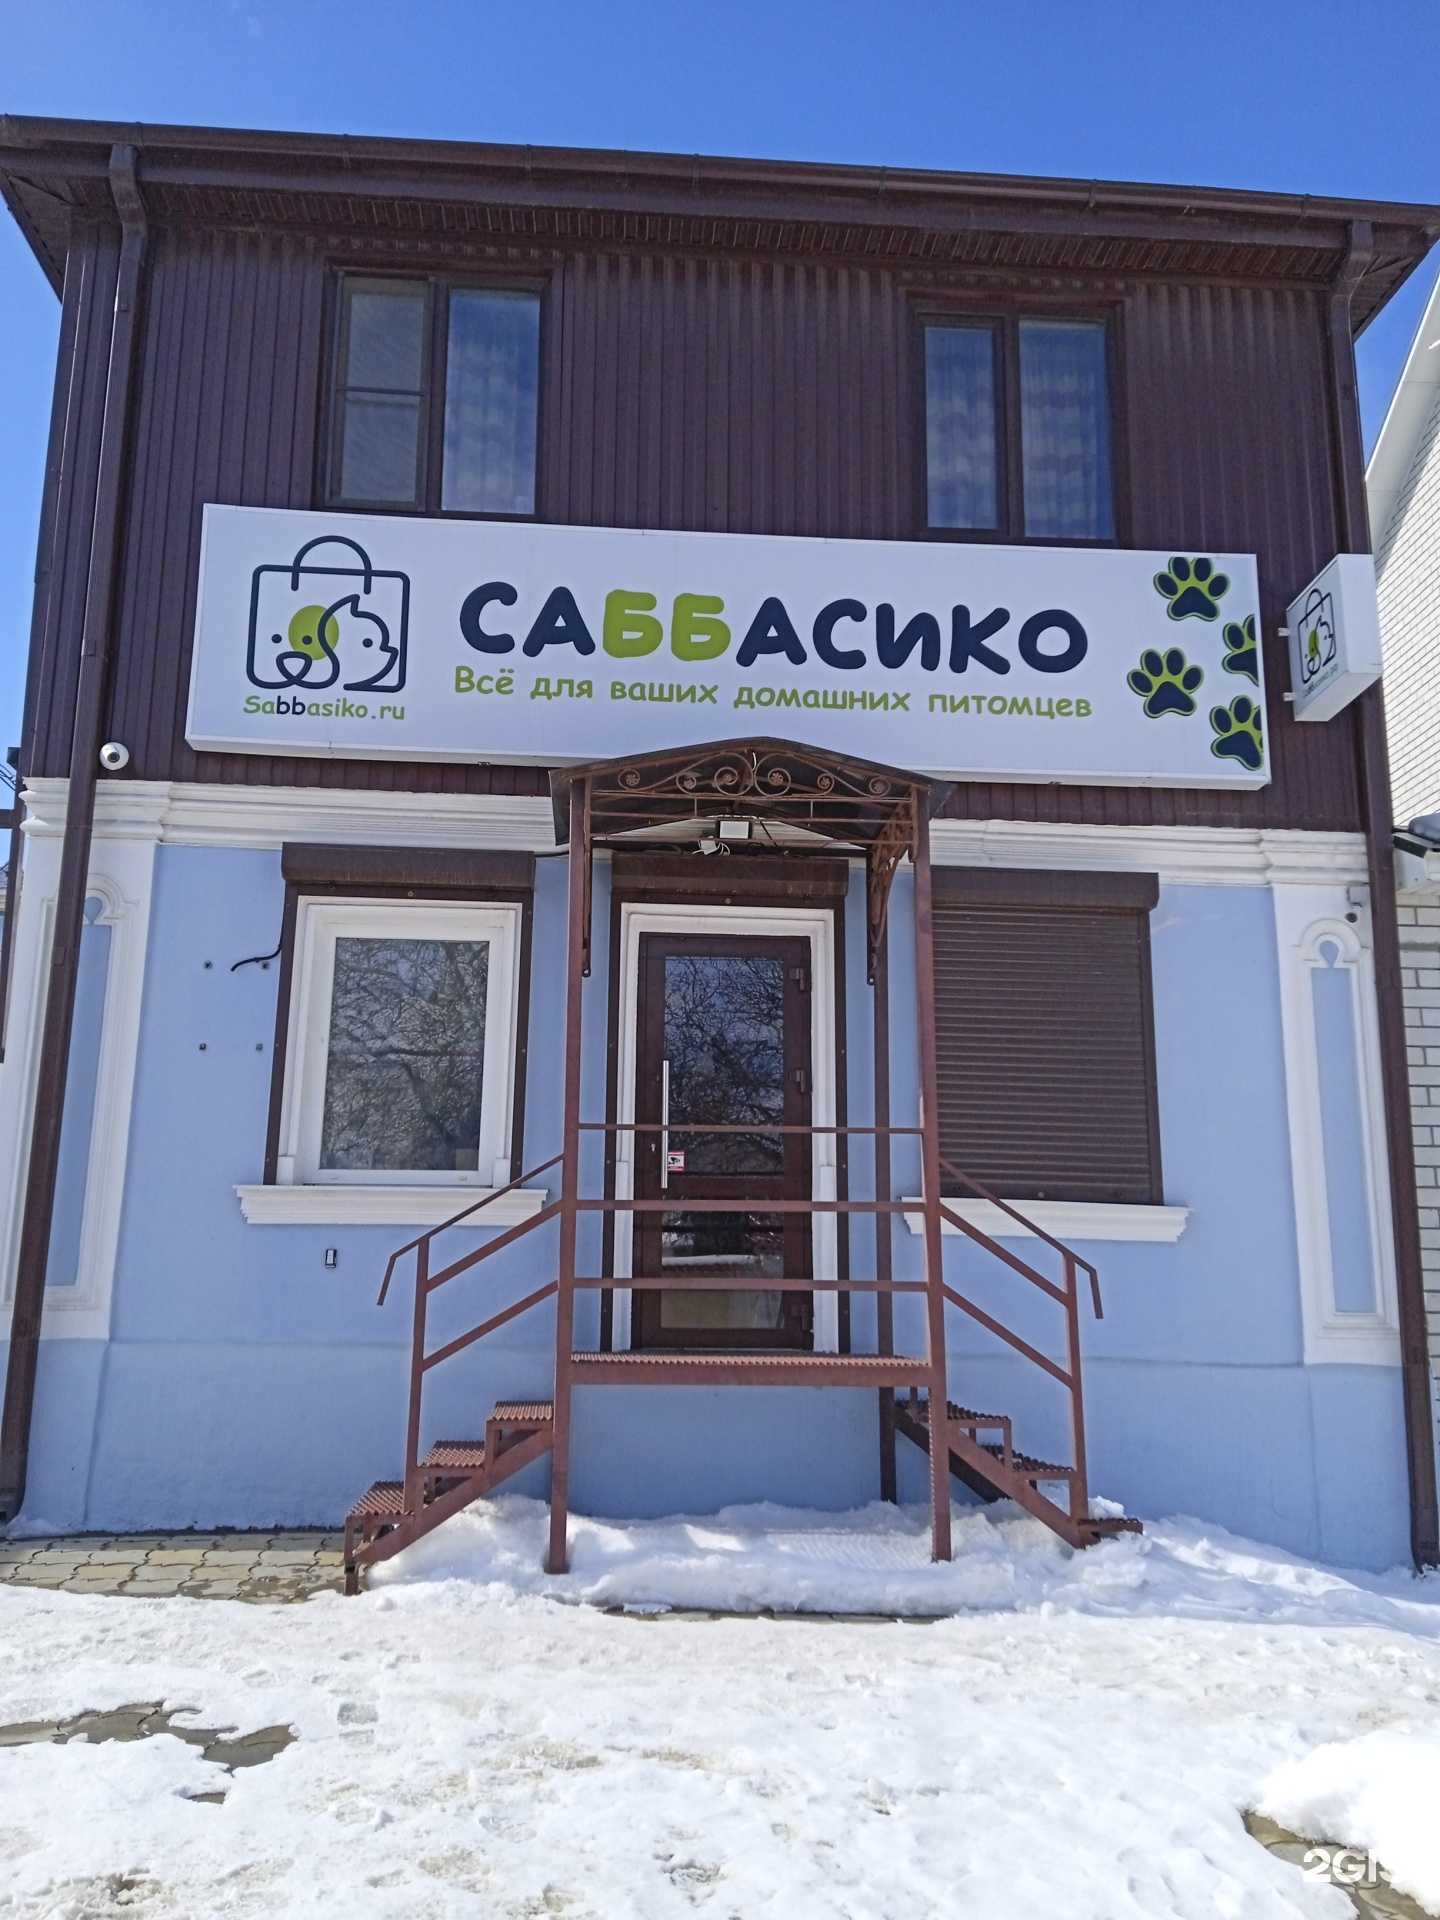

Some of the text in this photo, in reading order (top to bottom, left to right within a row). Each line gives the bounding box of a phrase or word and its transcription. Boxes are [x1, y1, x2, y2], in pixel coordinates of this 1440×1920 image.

[459, 581, 1088, 675] САББАСИКО
[243, 695, 405, 720] Sabbasiko.ru
[454, 665, 1093, 719] Всё для ваших домашних питомцев
